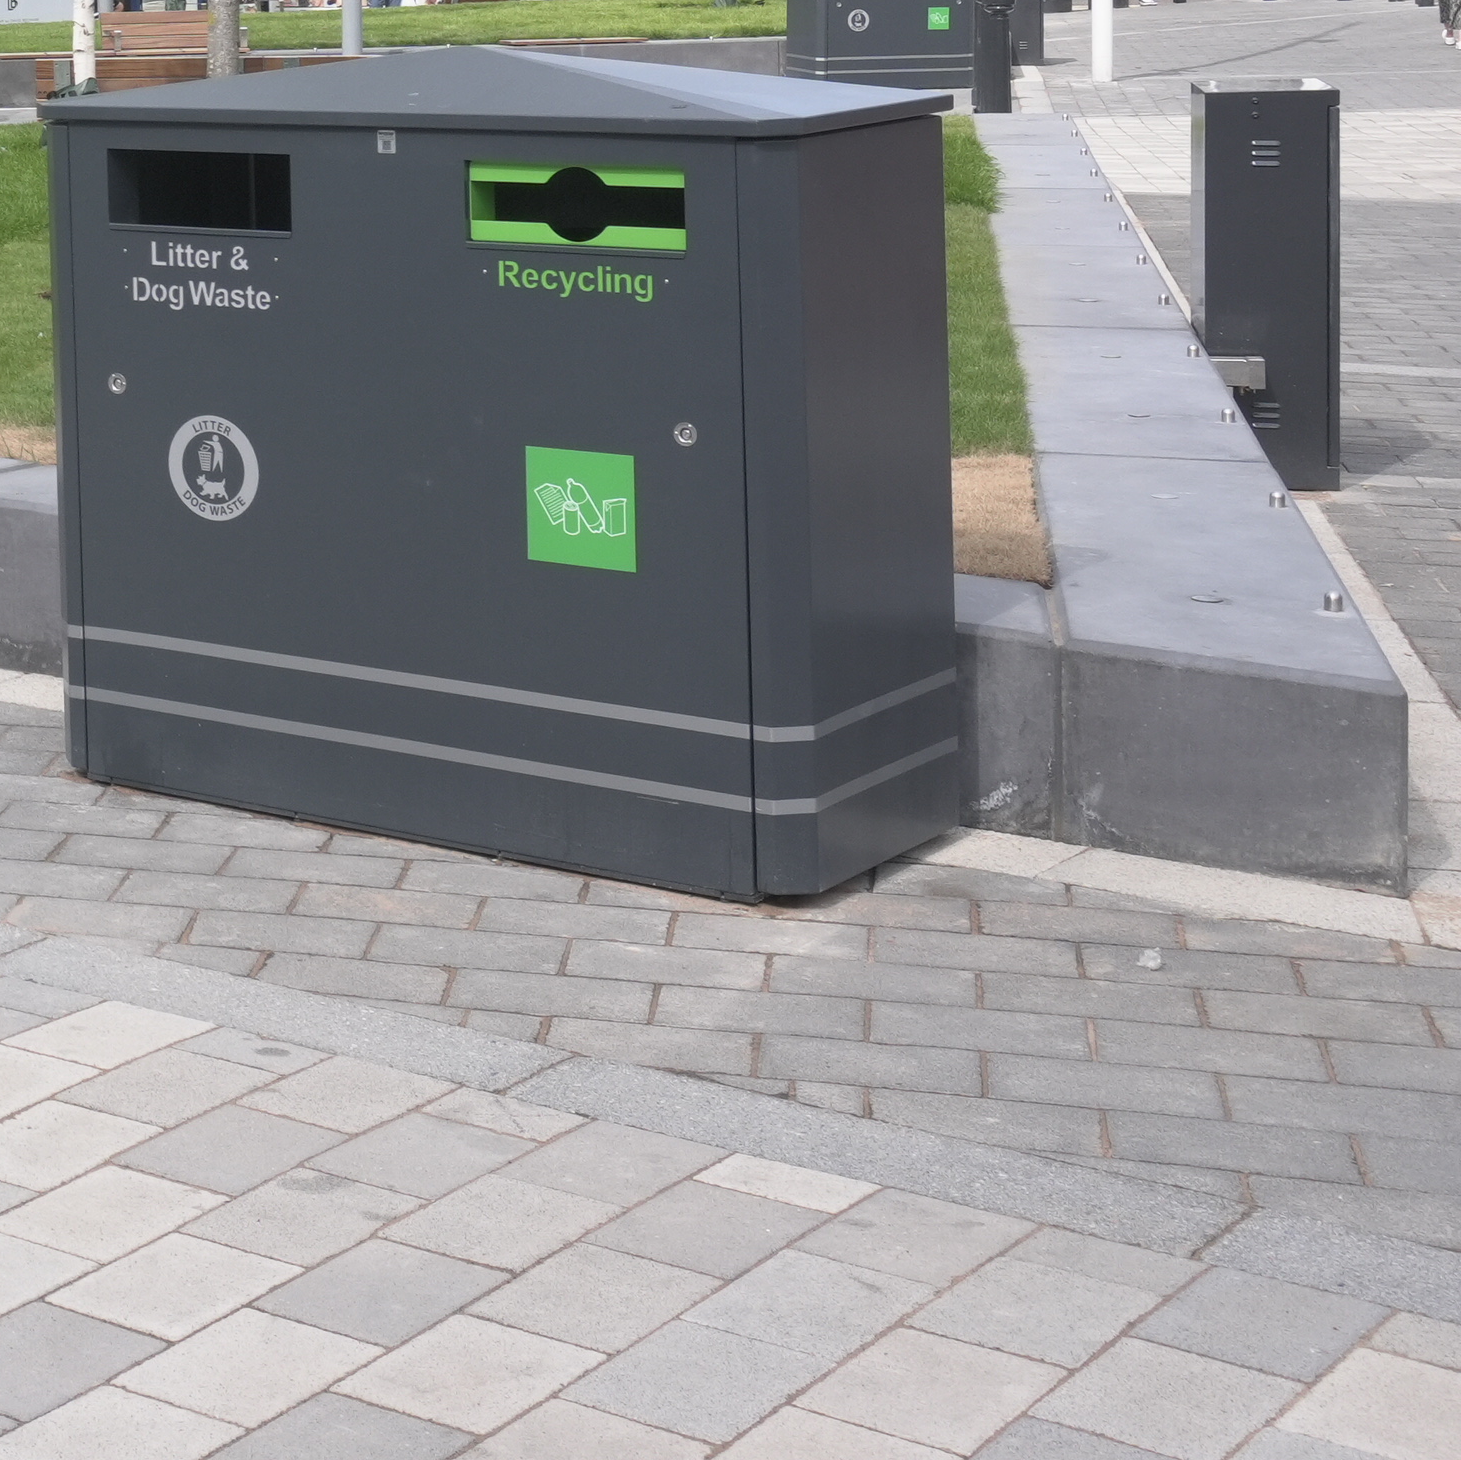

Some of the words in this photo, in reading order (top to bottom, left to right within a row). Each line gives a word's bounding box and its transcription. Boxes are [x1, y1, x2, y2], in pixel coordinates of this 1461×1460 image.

[150, 240, 223, 271] Litter
[229, 245, 250, 272] &
[132, 276, 186, 311] Dog
[188, 280, 272, 311] Waste
[497, 259, 655, 304] Recycling
[192, 420, 232, 437] LITTER
[182, 489, 208, 513] DOG
[209, 495, 247, 517] WASTE
